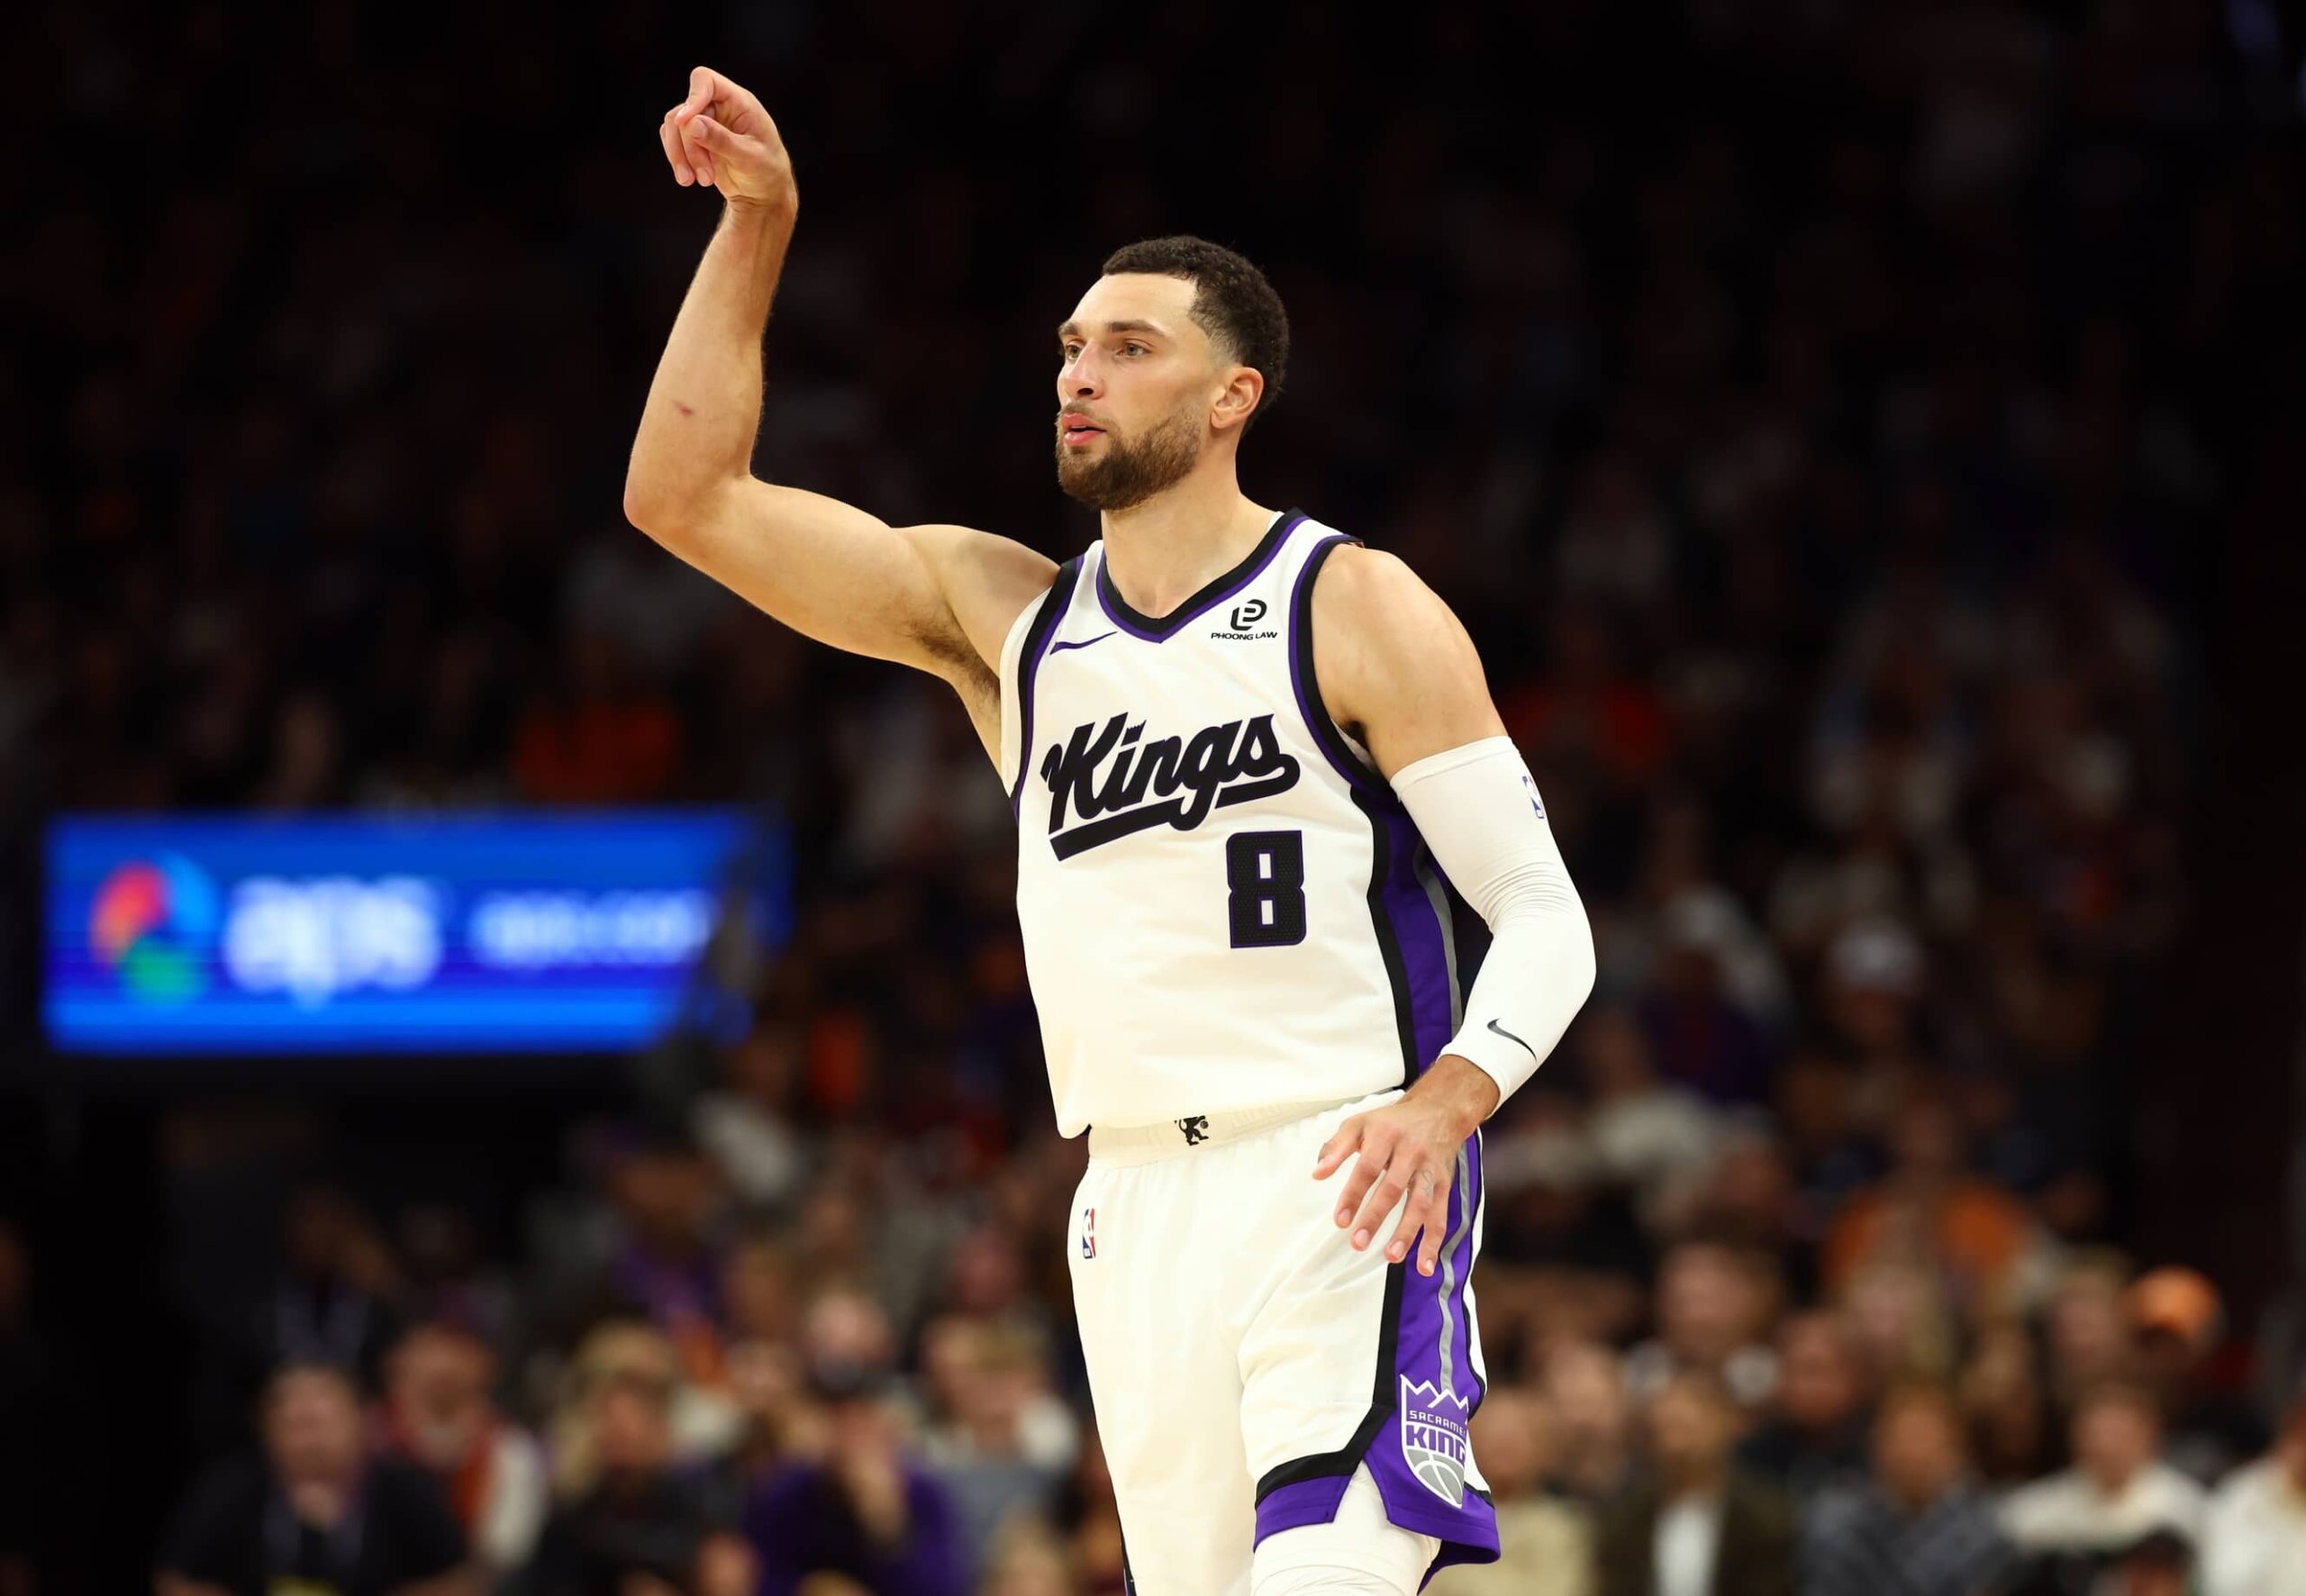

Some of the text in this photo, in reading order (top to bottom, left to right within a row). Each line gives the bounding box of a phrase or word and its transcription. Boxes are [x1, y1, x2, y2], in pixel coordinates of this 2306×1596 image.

[1211, 631, 1277, 640] PHOONG LAW
[1040, 712, 1301, 862] Kings
[1226, 830, 1307, 949] 8
